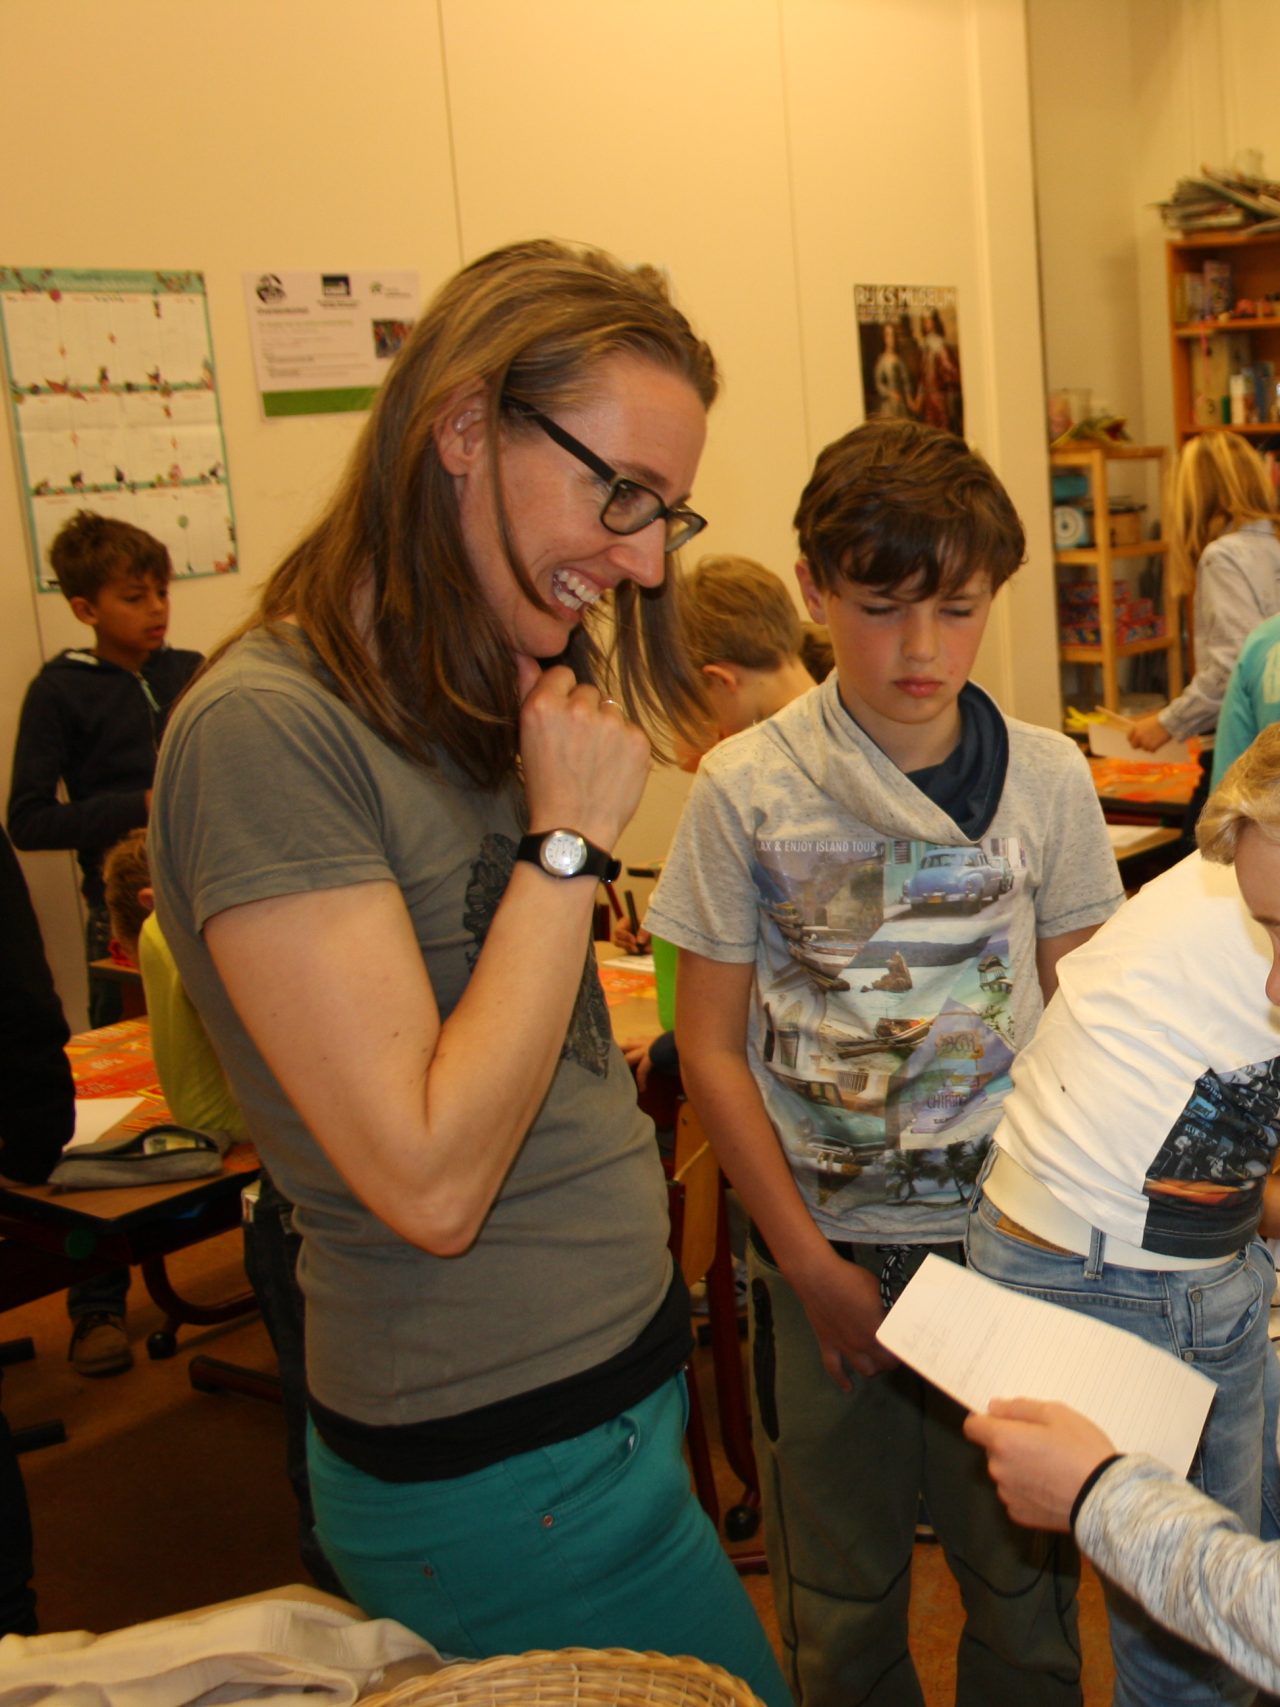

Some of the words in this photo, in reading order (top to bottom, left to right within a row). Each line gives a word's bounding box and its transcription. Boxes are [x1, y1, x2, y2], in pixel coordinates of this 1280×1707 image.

[784, 841, 813, 852] ENJOY
[815, 841, 849, 852] ISLAND
[852, 841, 877, 852] TOUR
